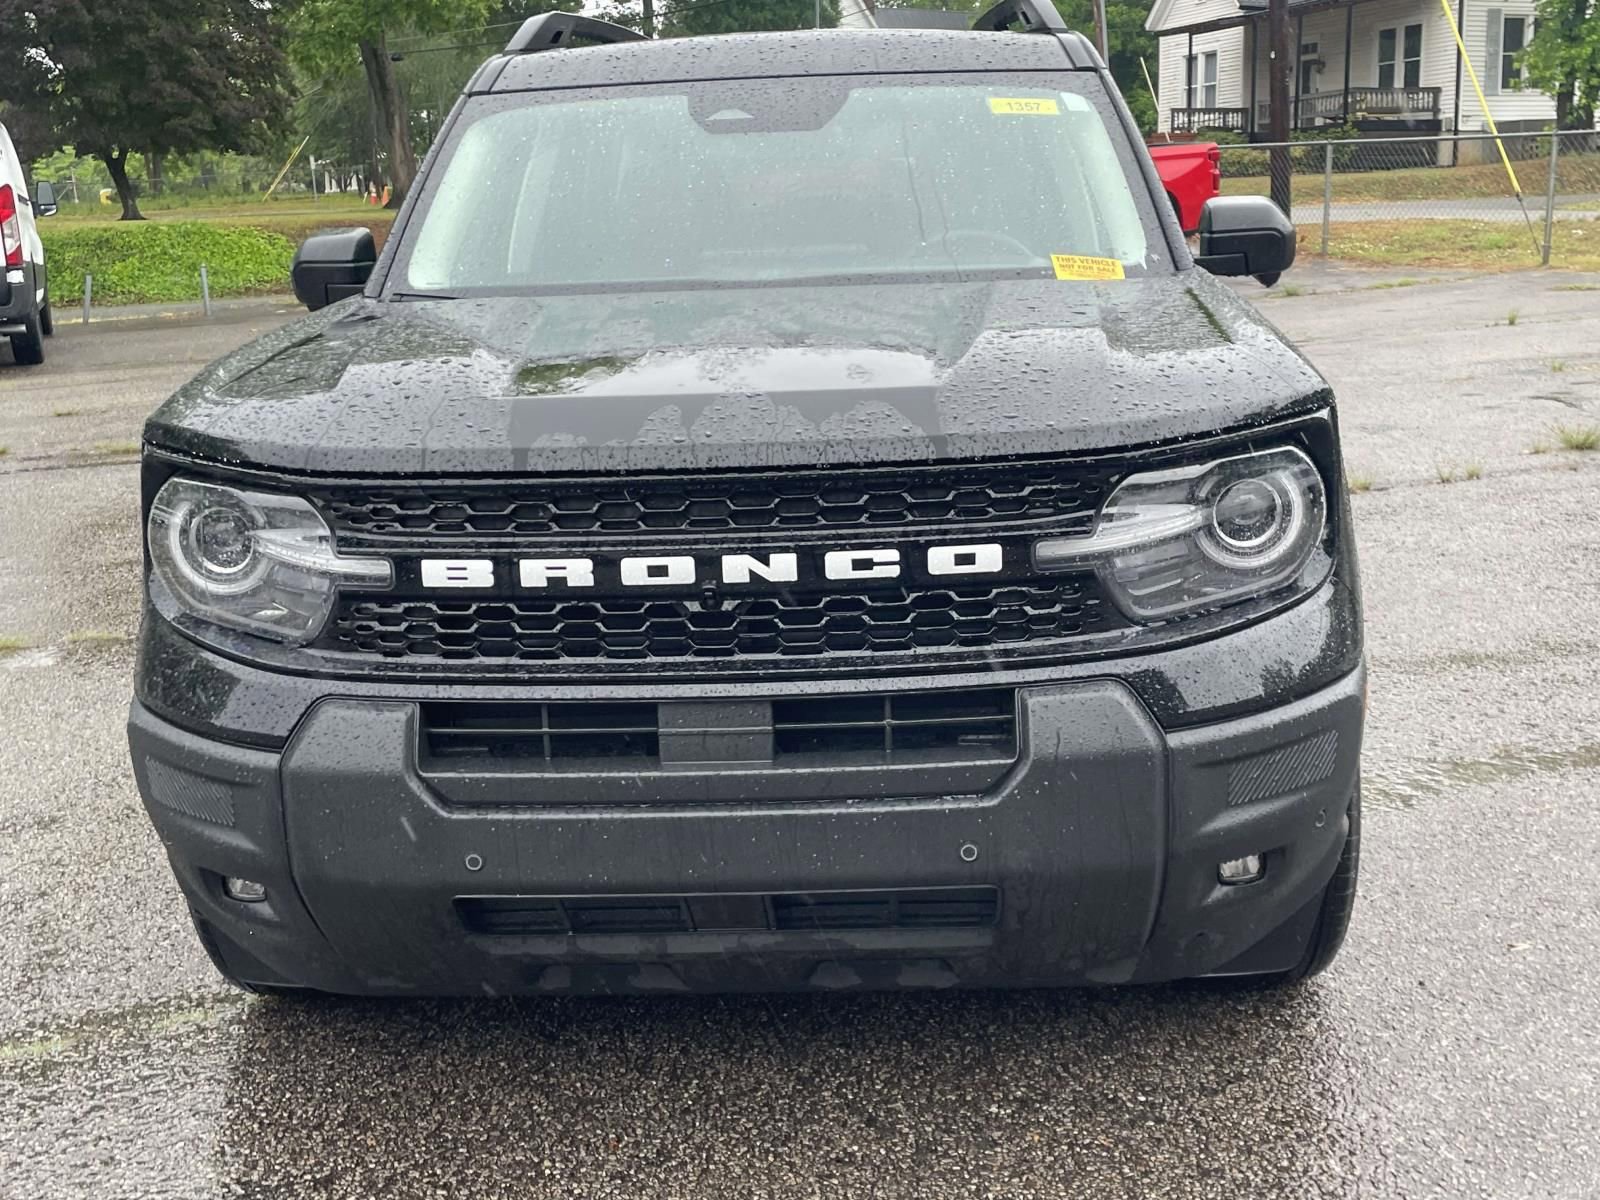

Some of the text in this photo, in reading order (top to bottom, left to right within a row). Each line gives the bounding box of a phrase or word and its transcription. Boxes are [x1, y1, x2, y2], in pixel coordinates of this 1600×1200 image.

[1007, 102, 1041, 112] 1357
[1055, 256, 1116, 267] THIS VEHICLE
[421, 543, 1003, 589] BRONCO
